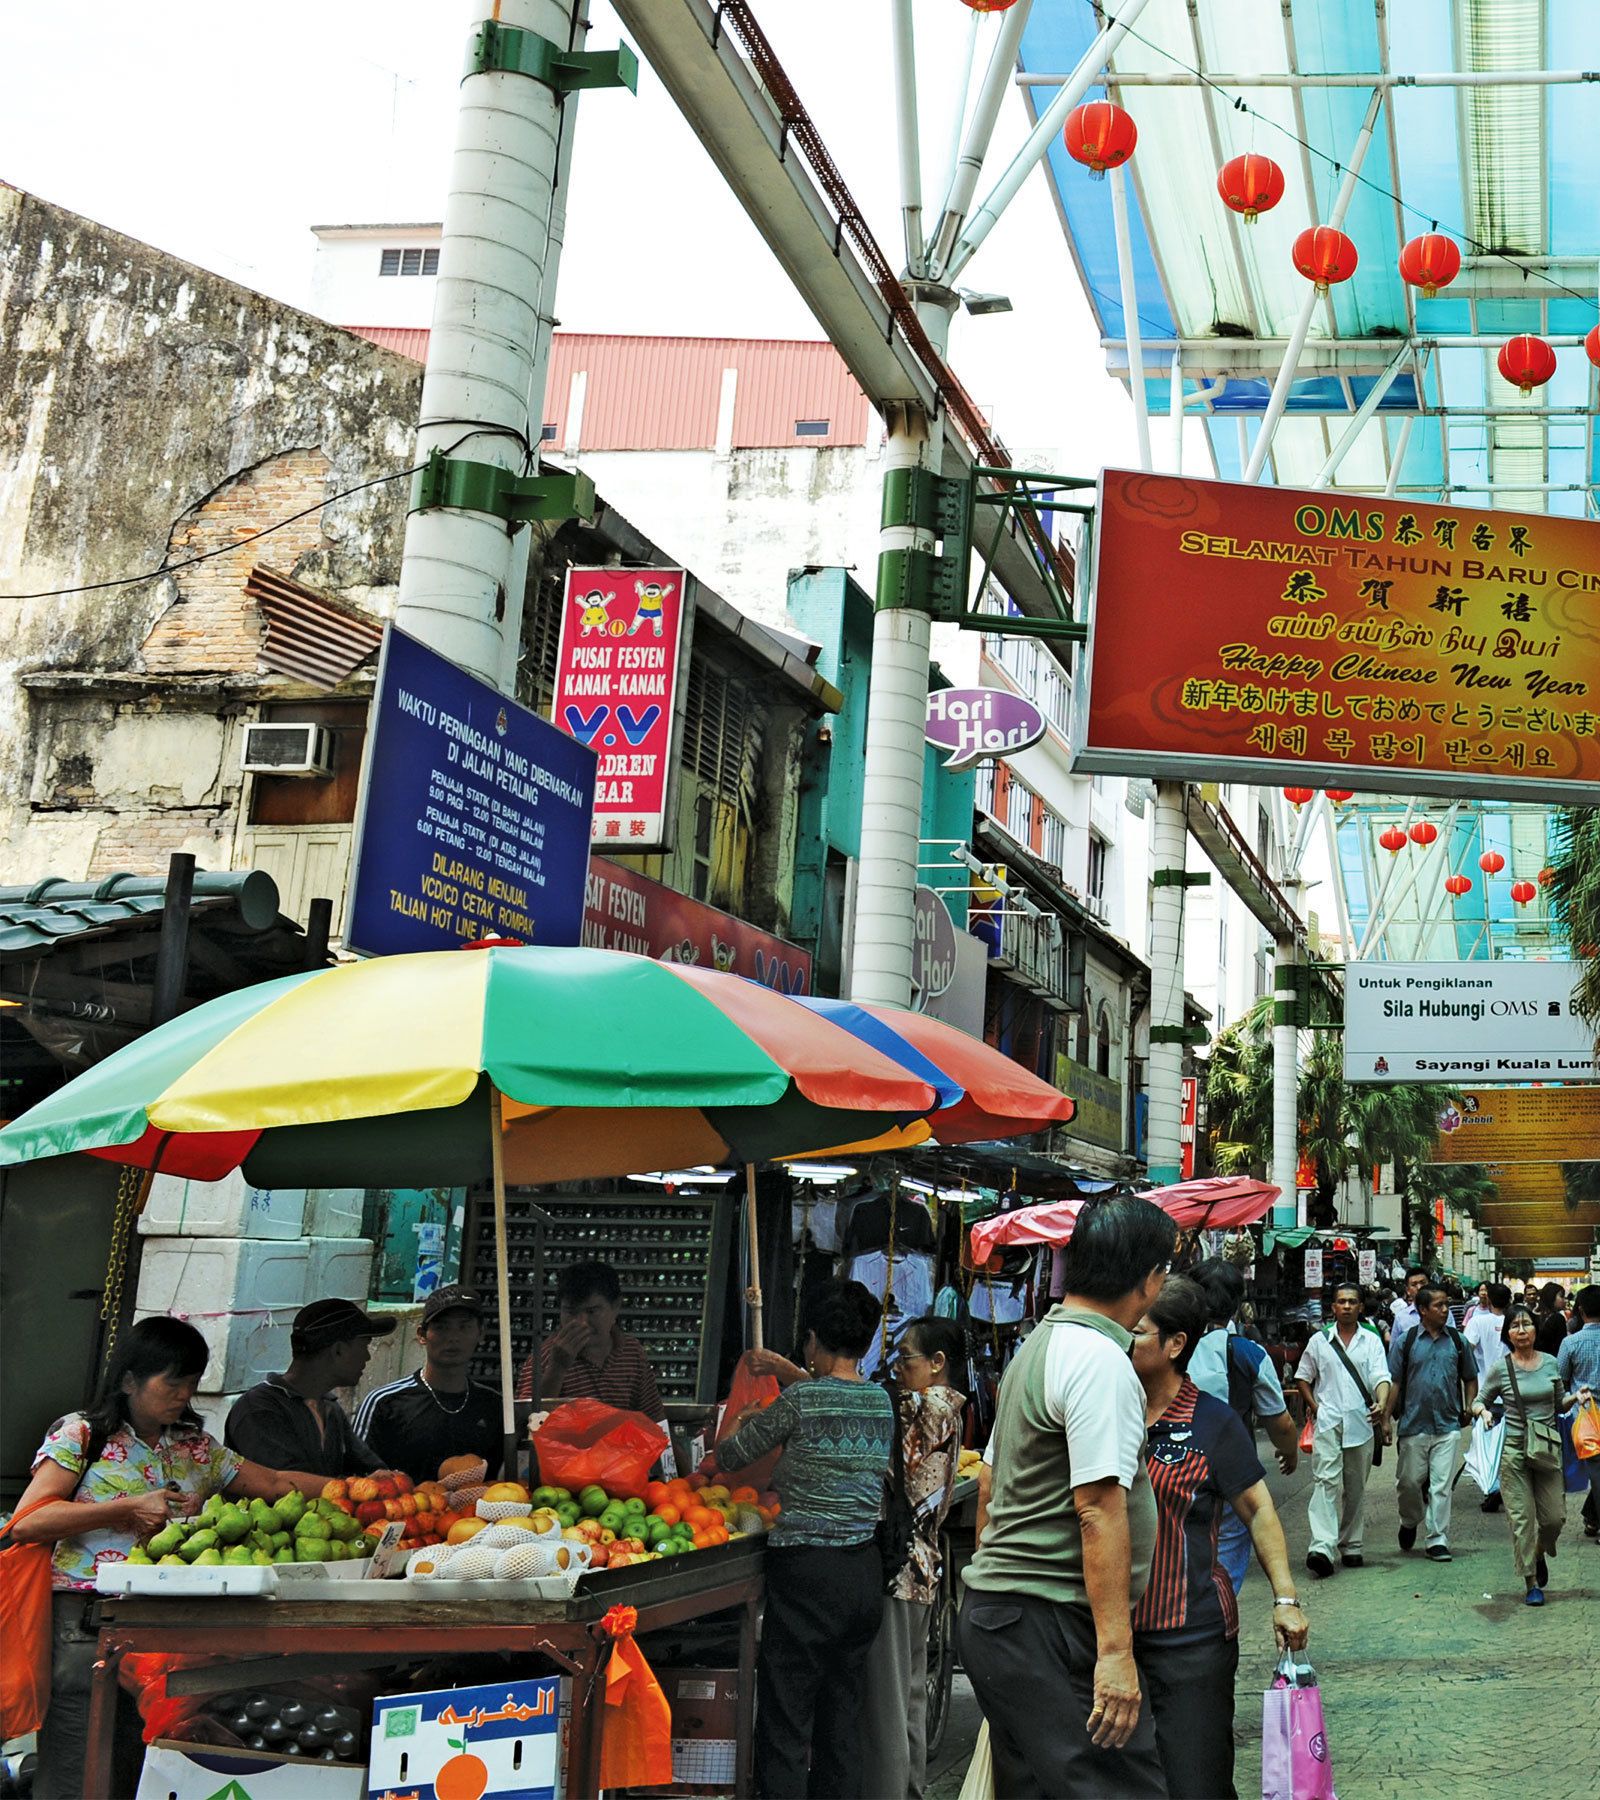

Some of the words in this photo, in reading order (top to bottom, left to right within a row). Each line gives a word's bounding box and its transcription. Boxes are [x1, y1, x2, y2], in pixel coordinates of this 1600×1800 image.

[1295, 504, 1385, 543] OMS
[571, 646, 613, 669] PUSAT
[617, 646, 666, 669] FESYEN
[1219, 643, 1322, 679] Happy
[1330, 654, 1439, 685] Chinese
[1449, 662, 1513, 690] New
[1523, 668, 1588, 697] Year
[564, 673, 667, 696] KANAK-KANAK
[926, 692, 992, 721] Hari
[398, 687, 437, 726] WAKTU
[438, 711, 501, 762] PERNIAGAAN
[504, 747, 528, 777] YANG
[530, 763, 584, 808] DIBENARKAN
[958, 720, 1028, 749] Hari
[1247, 725, 1307, 756] 새해
[1325, 728, 1355, 758] 복
[1371, 732, 1426, 763] 많이
[447, 741, 458, 763] DI
[461, 750, 494, 783] JALAN
[496, 767, 538, 806] PETALING
[429, 785, 444, 802] 9.00
[446, 790, 463, 811] PAGI
[472, 803, 490, 823] 12.00
[492, 812, 519, 837] TENGAH
[520, 825, 544, 850] MALAM
[431, 769, 464, 796] PENJAJA
[466, 786, 490, 809] STATIK
[491, 796, 500, 812] (DI
[502, 801, 521, 820] BAHU
[522, 811, 545, 837] JALAN)
[416, 819, 432, 837] 6.00
[434, 825, 466, 850] PETANG
[475, 850, 492, 869] 12.00
[494, 853, 521, 877] TENGAH
[522, 866, 546, 887] MALAM
[426, 805, 460, 834] PENJAJA
[462, 822, 486, 844] STATIK
[489, 835, 499, 850] (DI
[500, 840, 518, 858] ATAS
[518, 848, 542, 872] JALAN)
[432, 852, 485, 891] DILARANG
[487, 874, 529, 910] MENJUAL
[390, 890, 428, 922] TALIAN
[430, 908, 453, 931] HOT
[455, 917, 477, 940] LINE
[421, 874, 459, 906] VCD/CD
[462, 890, 495, 921] CETAK
[498, 907, 536, 938] ROMPAK
[608, 882, 646, 928] FESYEN
[921, 943, 950, 990] Hari
[1358, 976, 1402, 989] Untuk
[1405, 976, 1493, 991] Pengiklanan
[1383, 999, 1414, 1017] Sila
[1418, 998, 1485, 1021] Hubungi
[1490, 999, 1538, 1017] OMS
[1415, 1058, 1491, 1073] Sayangi
[1497, 1058, 1552, 1071] Kuala
[1461, 1115, 1494, 1125] Rabbit
